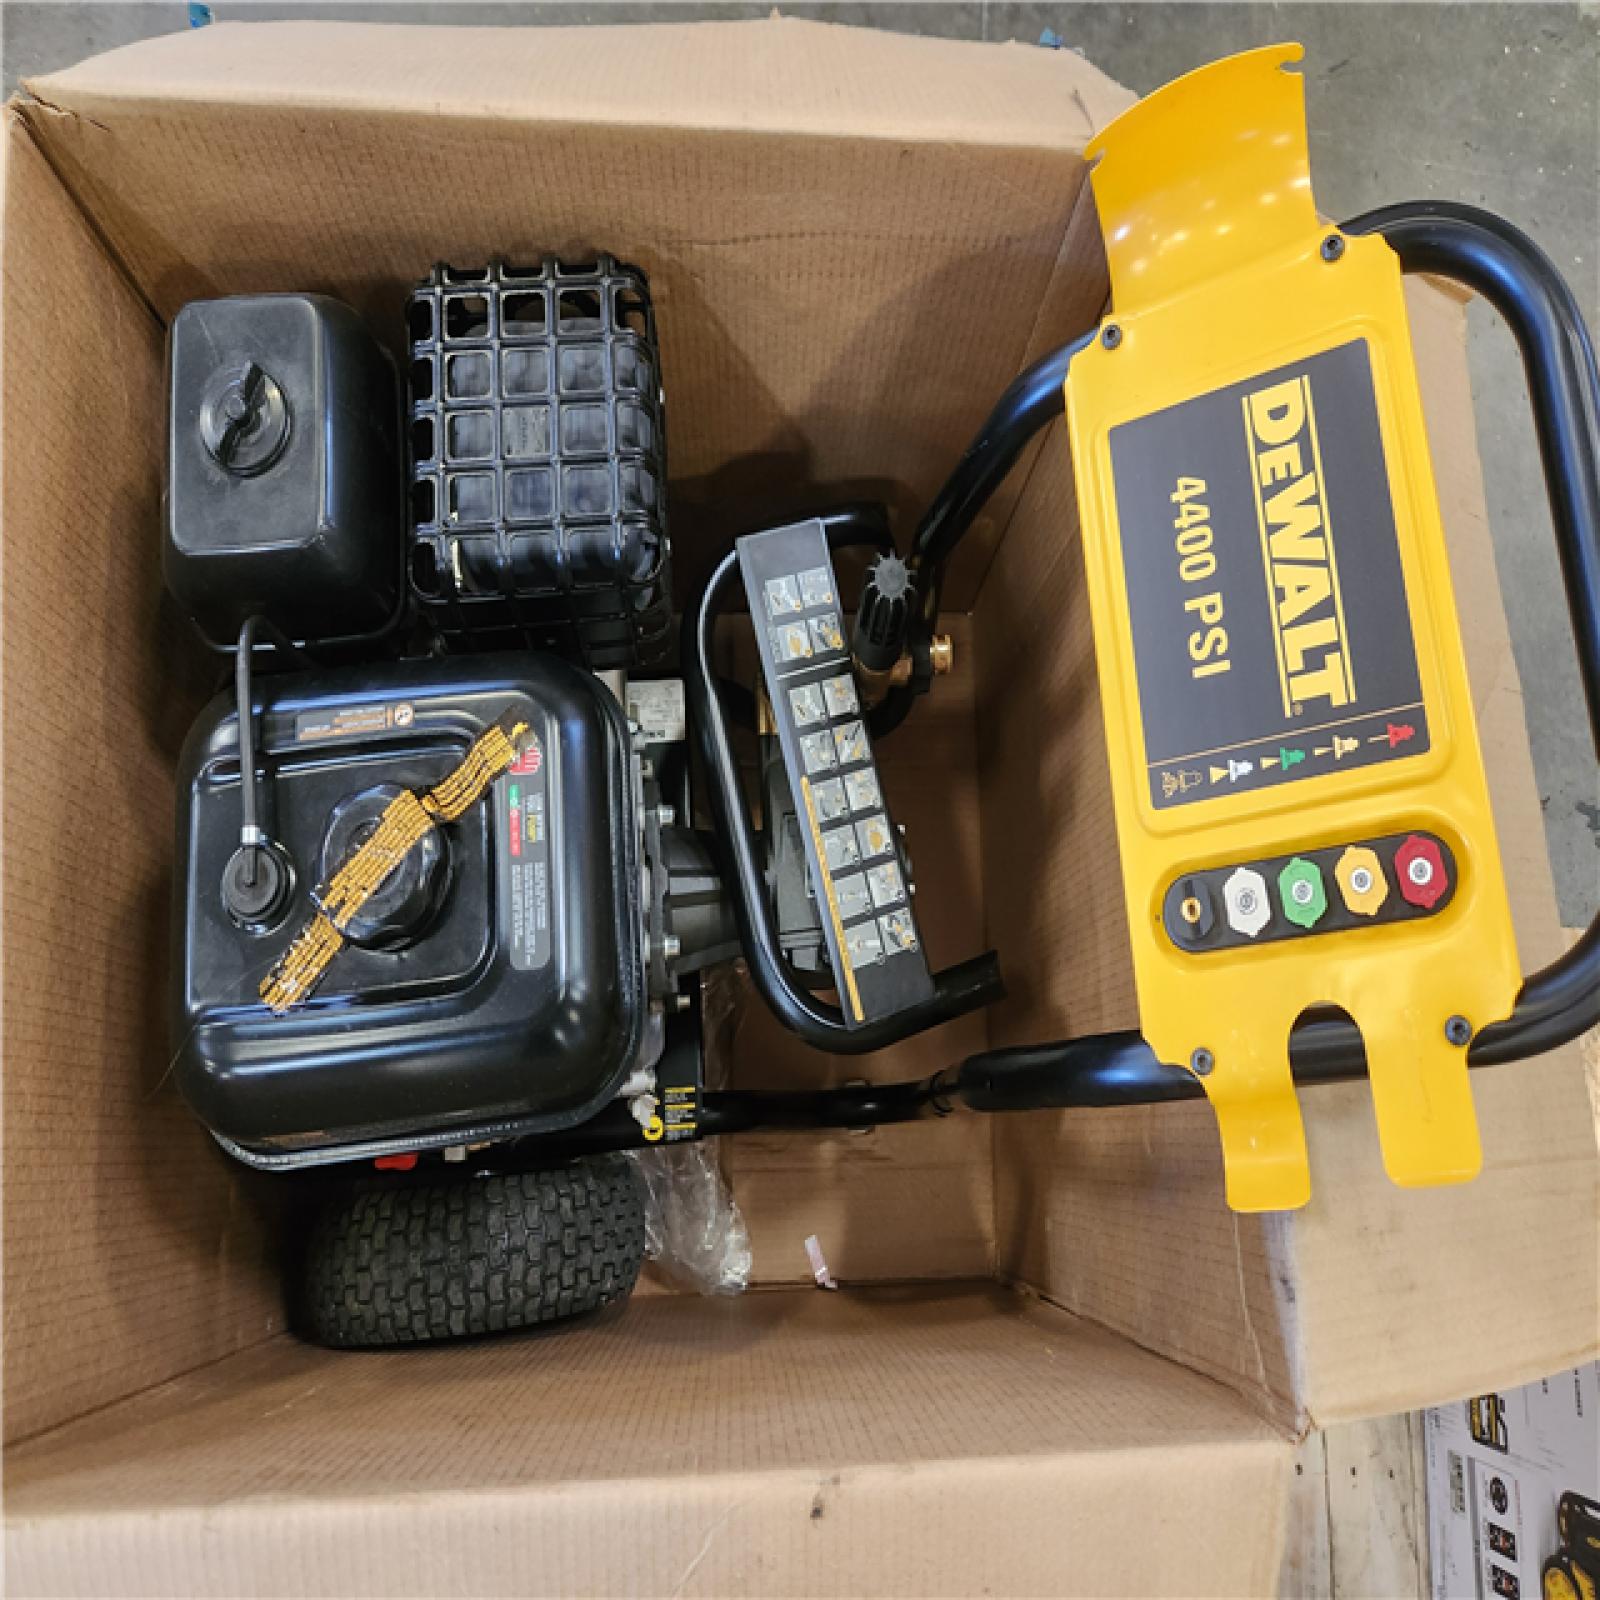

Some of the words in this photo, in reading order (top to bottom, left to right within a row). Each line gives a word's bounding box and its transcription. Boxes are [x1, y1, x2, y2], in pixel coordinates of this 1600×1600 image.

[1170, 476, 1217, 582] 4400
[1248, 376, 1349, 708] DEWALT
[1184, 591, 1231, 678] PSI
